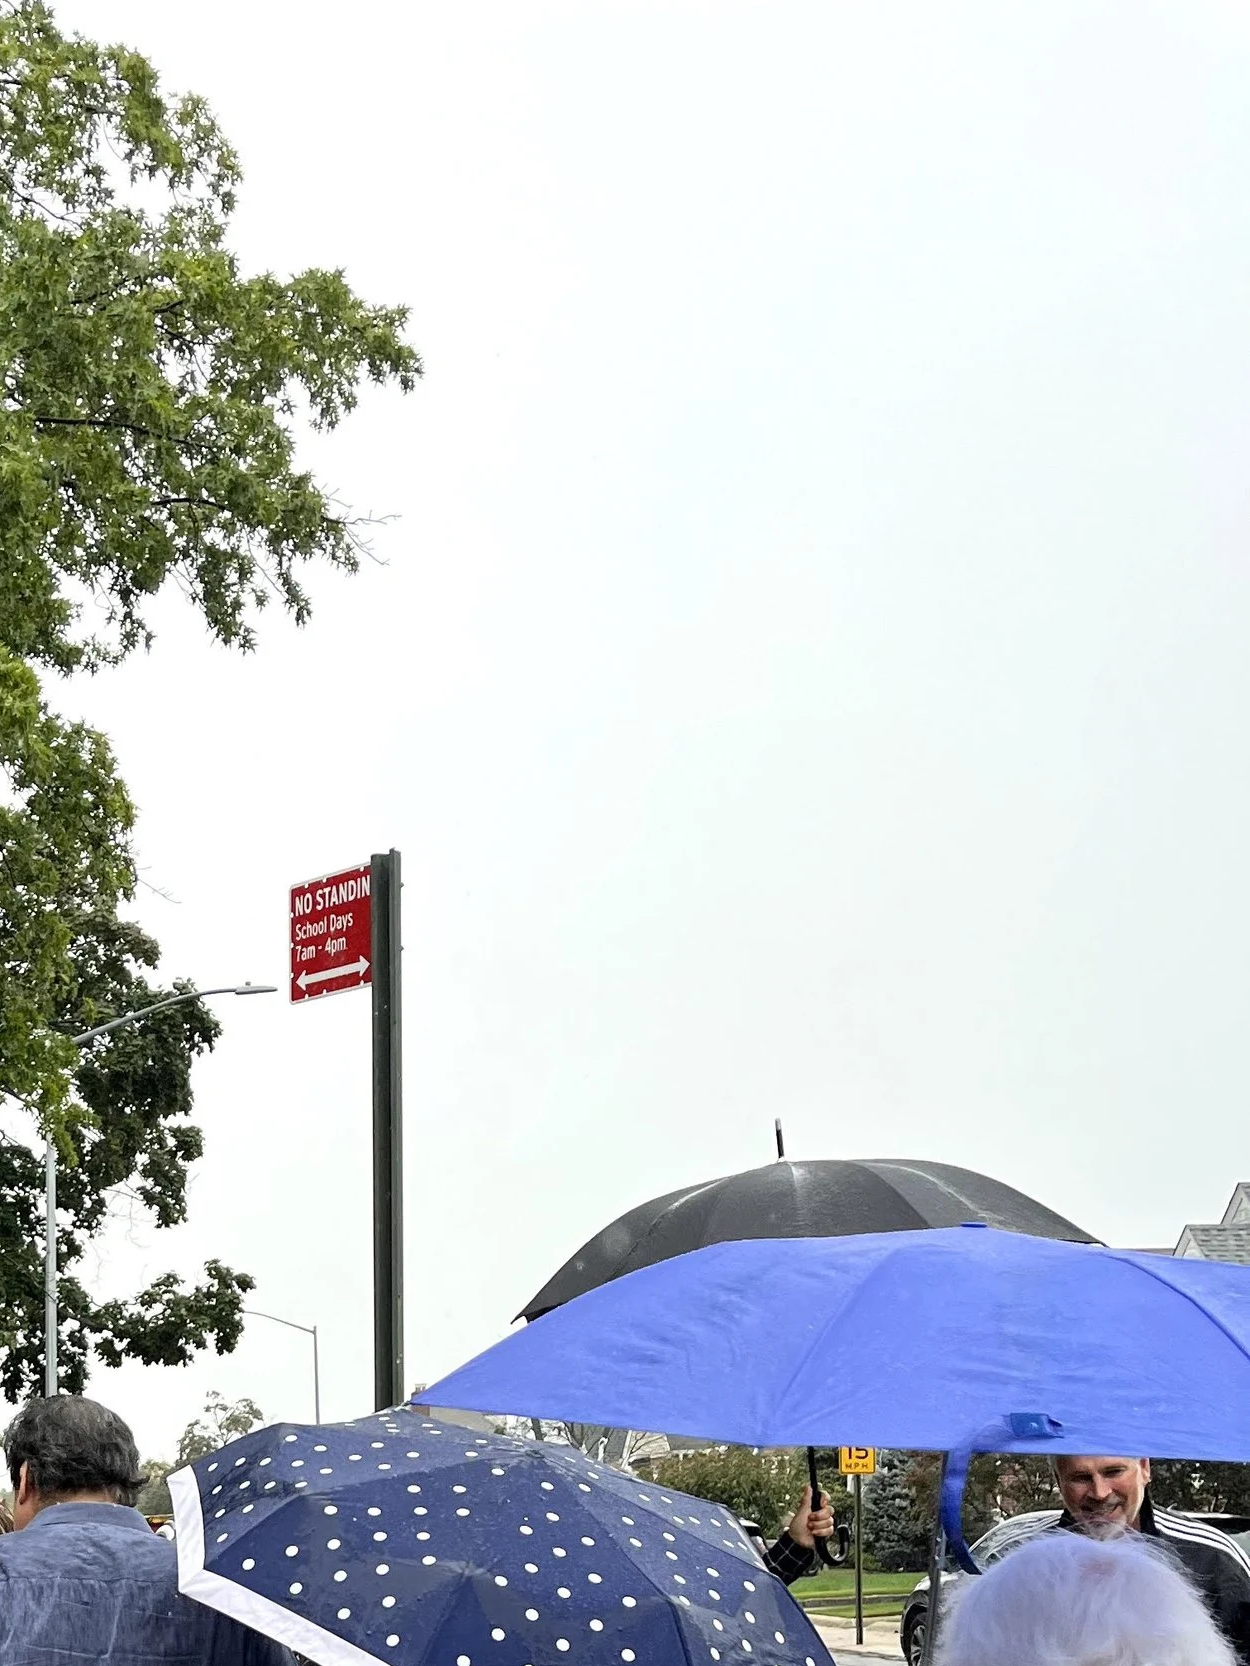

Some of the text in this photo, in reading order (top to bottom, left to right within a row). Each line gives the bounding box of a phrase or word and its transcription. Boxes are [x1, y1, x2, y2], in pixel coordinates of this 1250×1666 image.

[295, 875, 371, 916] NO STANDIN
[295, 912, 353, 940] School Days
[295, 944, 316, 962] 7am
[325, 937, 347, 956] 4pm
